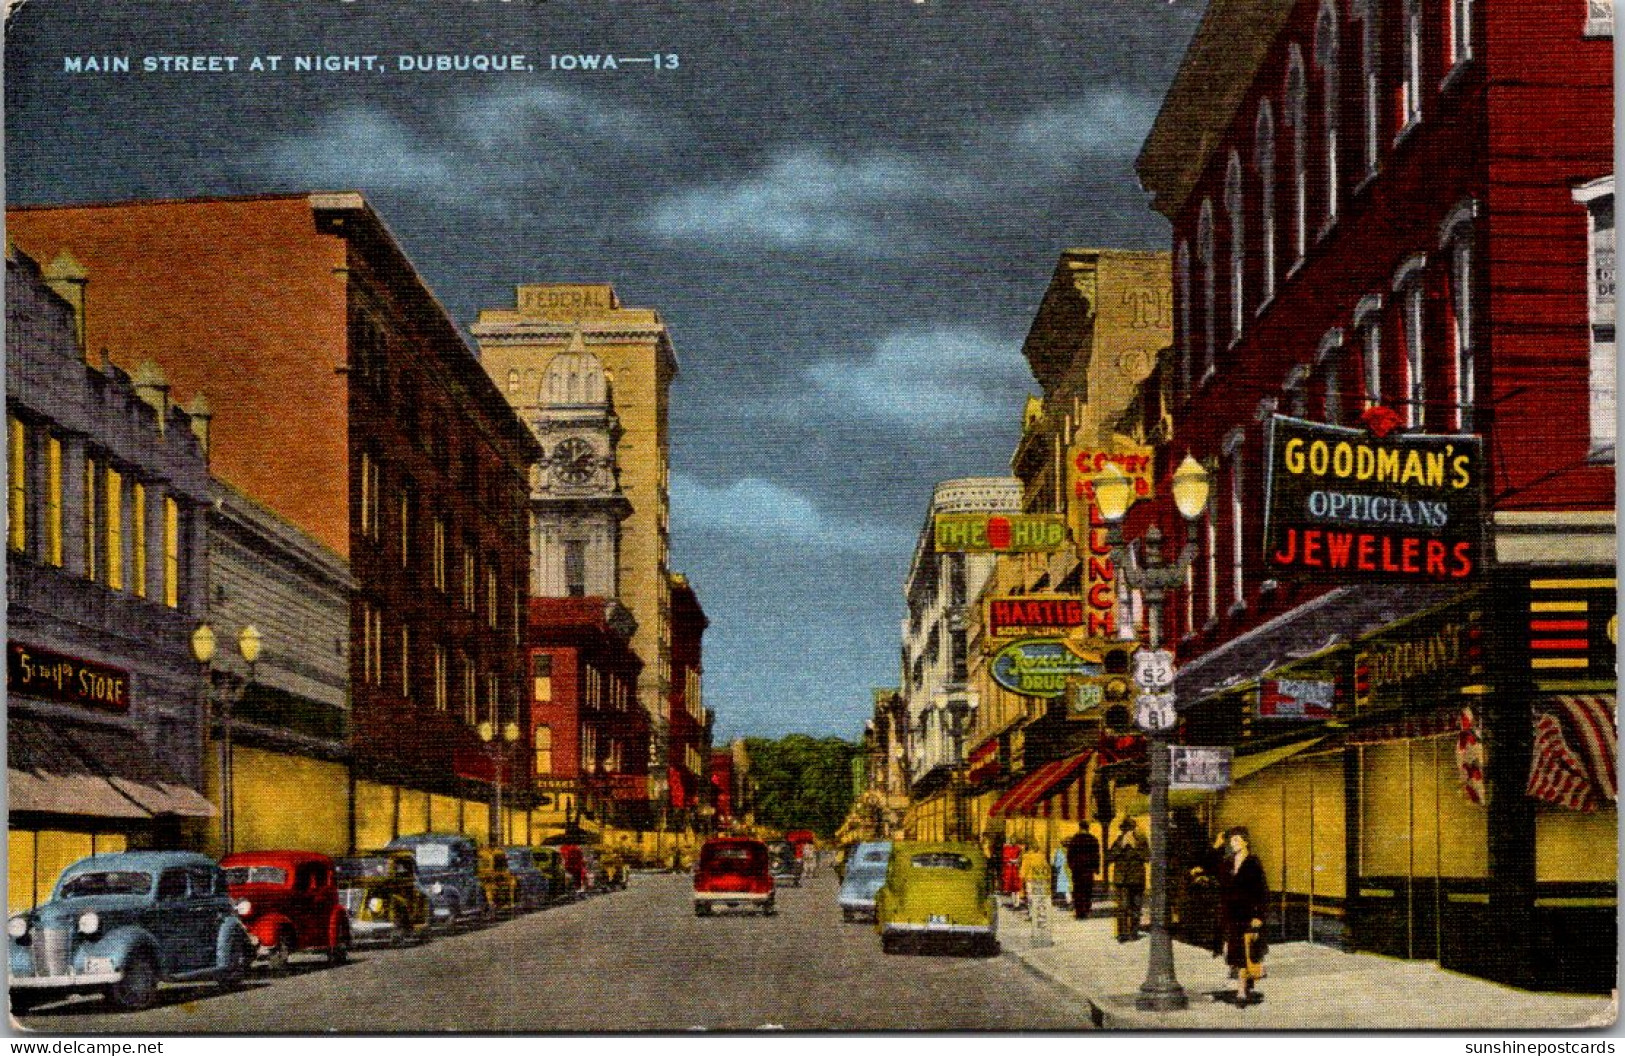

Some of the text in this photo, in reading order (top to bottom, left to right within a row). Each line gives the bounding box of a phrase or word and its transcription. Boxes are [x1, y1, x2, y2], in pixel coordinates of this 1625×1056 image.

[1285, 437, 1470, 489] GOODMAN'S
[1308, 490, 1449, 527] OPTICIANS
[939, 520, 1065, 546] THE HUB
[1088, 503, 1114, 638] LUNCH
[1274, 529, 1473, 578] JEWELERS
[994, 600, 1081, 625] HARTIG
[79, 668, 124, 704] STORE
[1143, 668, 1166, 683] 52
